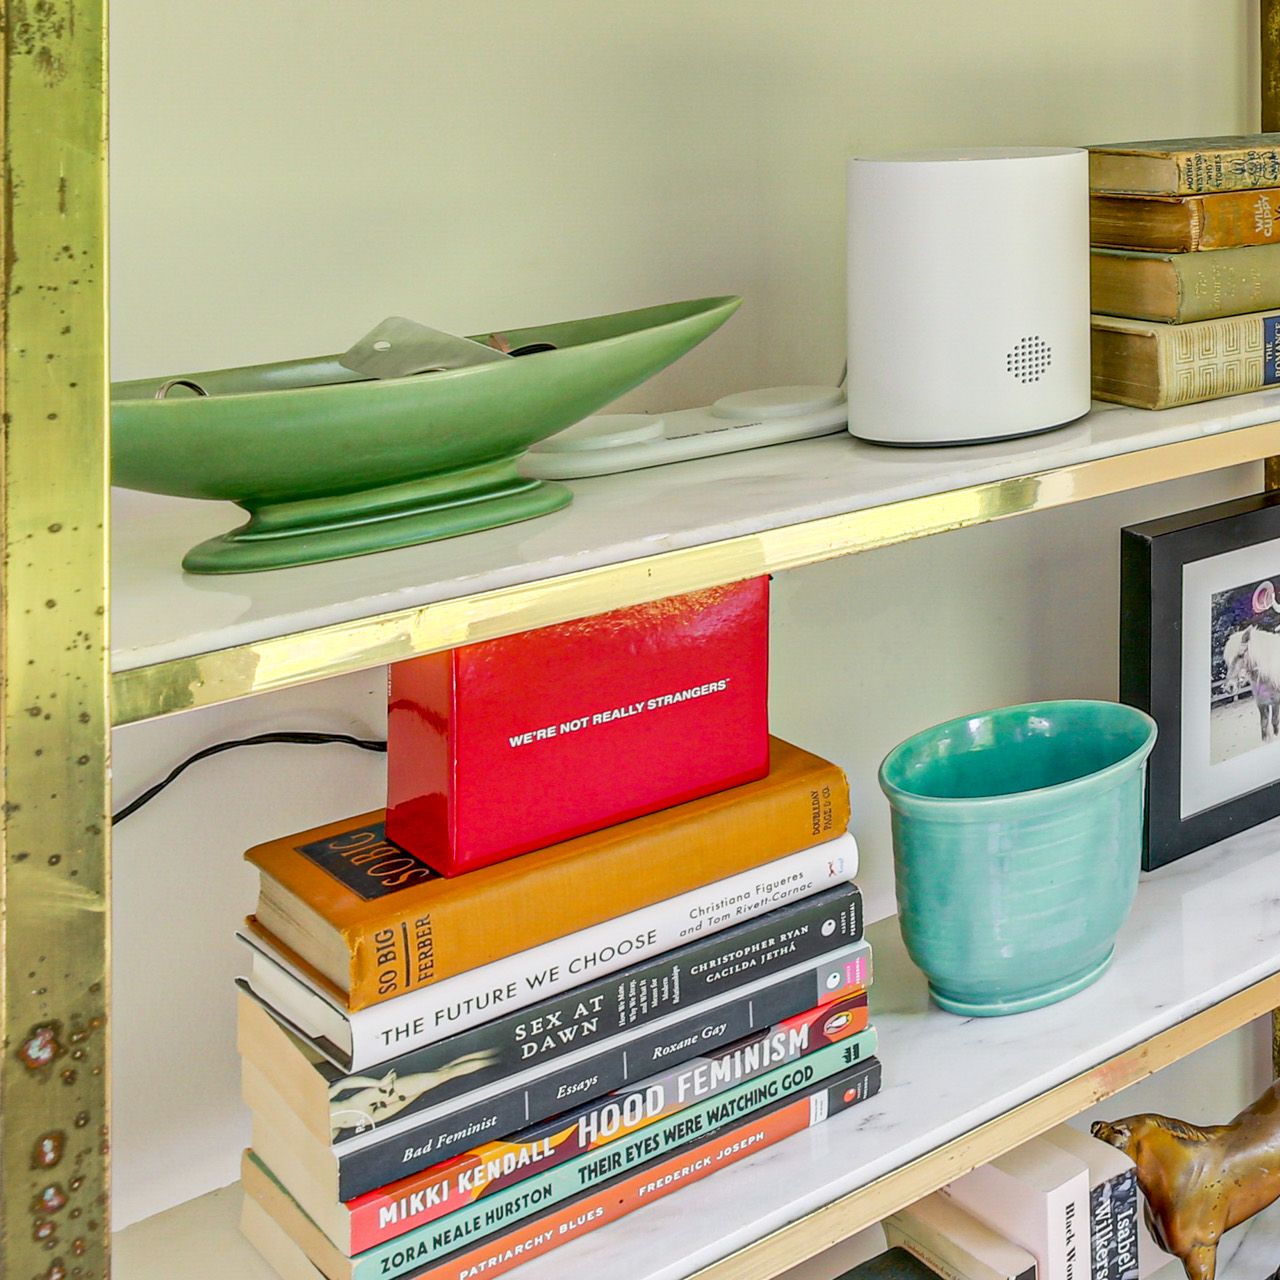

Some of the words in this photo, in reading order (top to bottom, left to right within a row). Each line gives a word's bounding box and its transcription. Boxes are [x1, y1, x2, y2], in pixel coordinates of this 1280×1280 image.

[1255, 199, 1265, 233] WILL
[509, 726, 557, 748] WE'RE
[559, 717, 590, 735] NOT
[592, 702, 645, 725] REALLY
[647, 679, 727, 711] STRANGERS
[812, 790, 820, 835] DOUBLEDAY
[680, 922, 702, 937] and
[708, 912, 731, 927] Tom
[735, 880, 813, 916] Rivett-Carnac
[689, 891, 751, 920] Christiana
[755, 871, 804, 896] Figueres
[374, 928, 397, 970] BIG
[415, 913, 434, 983] FERBER
[690, 936, 776, 975] CHRISTOPHER
[780, 925, 809, 943] RYAN
[706, 958, 757, 983] CACILDA
[760, 940, 797, 965] JETHÁ
[378, 973, 397, 995] SO
[381, 1017, 424, 1046] THE
[434, 982, 517, 1026] FUTURE
[525, 966, 559, 991] WE
[568, 929, 657, 975] CHOOSE
[515, 1011, 562, 1041] SEX
[573, 994, 604, 1021] AT
[521, 1017, 601, 1060] DAWN
[401, 1141, 433, 1163] Bad
[437, 1115, 498, 1150] Feminist
[556, 1074, 599, 1100] Essays
[652, 1034, 698, 1060] Roxane
[701, 1023, 727, 1043] Gay
[378, 1179, 449, 1230] MIKKI
[457, 1136, 555, 1195] KENDALL
[577, 1081, 665, 1149] HOOD
[677, 1022, 810, 1104] FEMINISM
[380, 1240, 428, 1275] ZORA
[432, 1218, 482, 1251] NEALE
[485, 1183, 554, 1226] HURSTON
[578, 1151, 622, 1185] THEIR
[625, 1135, 661, 1164] EYES
[663, 1114, 704, 1147] WERE
[706, 1080, 778, 1126] WATCHING
[781, 1064, 815, 1092] GOD
[459, 1229, 554, 1280] PATRIARCHY
[559, 1206, 605, 1236] BLUES
[638, 1154, 713, 1197] FREDERICK
[716, 1131, 765, 1161] JOSEPH
[1065, 1201, 1076, 1247] Black
[1117, 1207, 1136, 1273] Isabel
